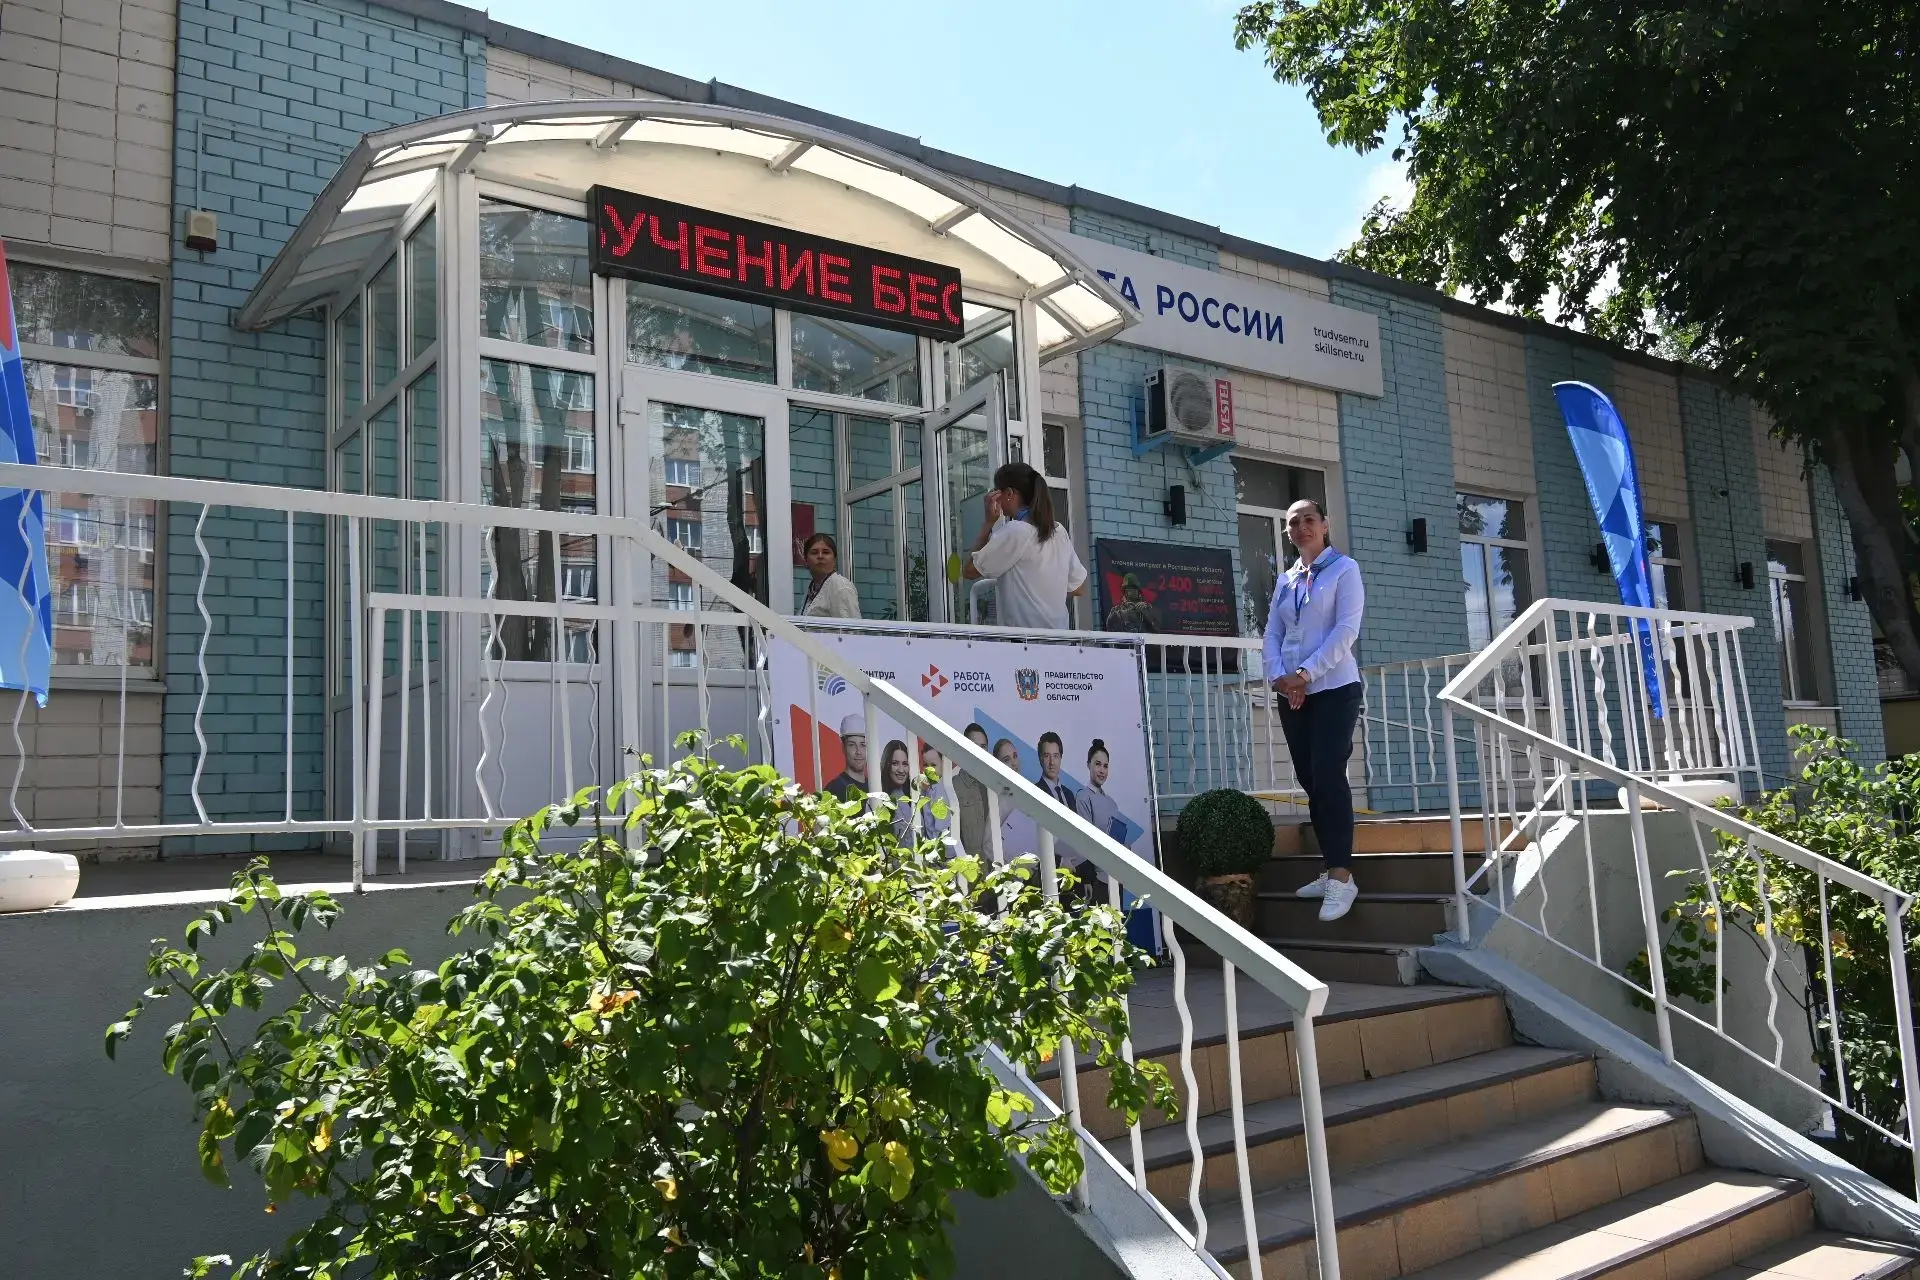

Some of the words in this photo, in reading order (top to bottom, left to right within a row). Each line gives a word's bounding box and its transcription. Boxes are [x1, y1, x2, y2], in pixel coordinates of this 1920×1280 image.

[601, 204, 852, 304] УЧЕНИЕ
[1156, 284, 1284, 344] РОССИИ
[1313, 326, 1369, 348] trudvsem.ru
[1314, 341, 1365, 362] skillsnet.ru
[1219, 381, 1231, 434] VESTEL
[953, 671, 991, 681] РАБОТА
[1044, 671, 1104, 680] ПРАВИТЕЛЬСТВО
[954, 682, 994, 692] РОССИИ
[1045, 682, 1093, 691] РОСТОВСКОЙ
[1046, 693, 1080, 701] ОБЛАСТИ
